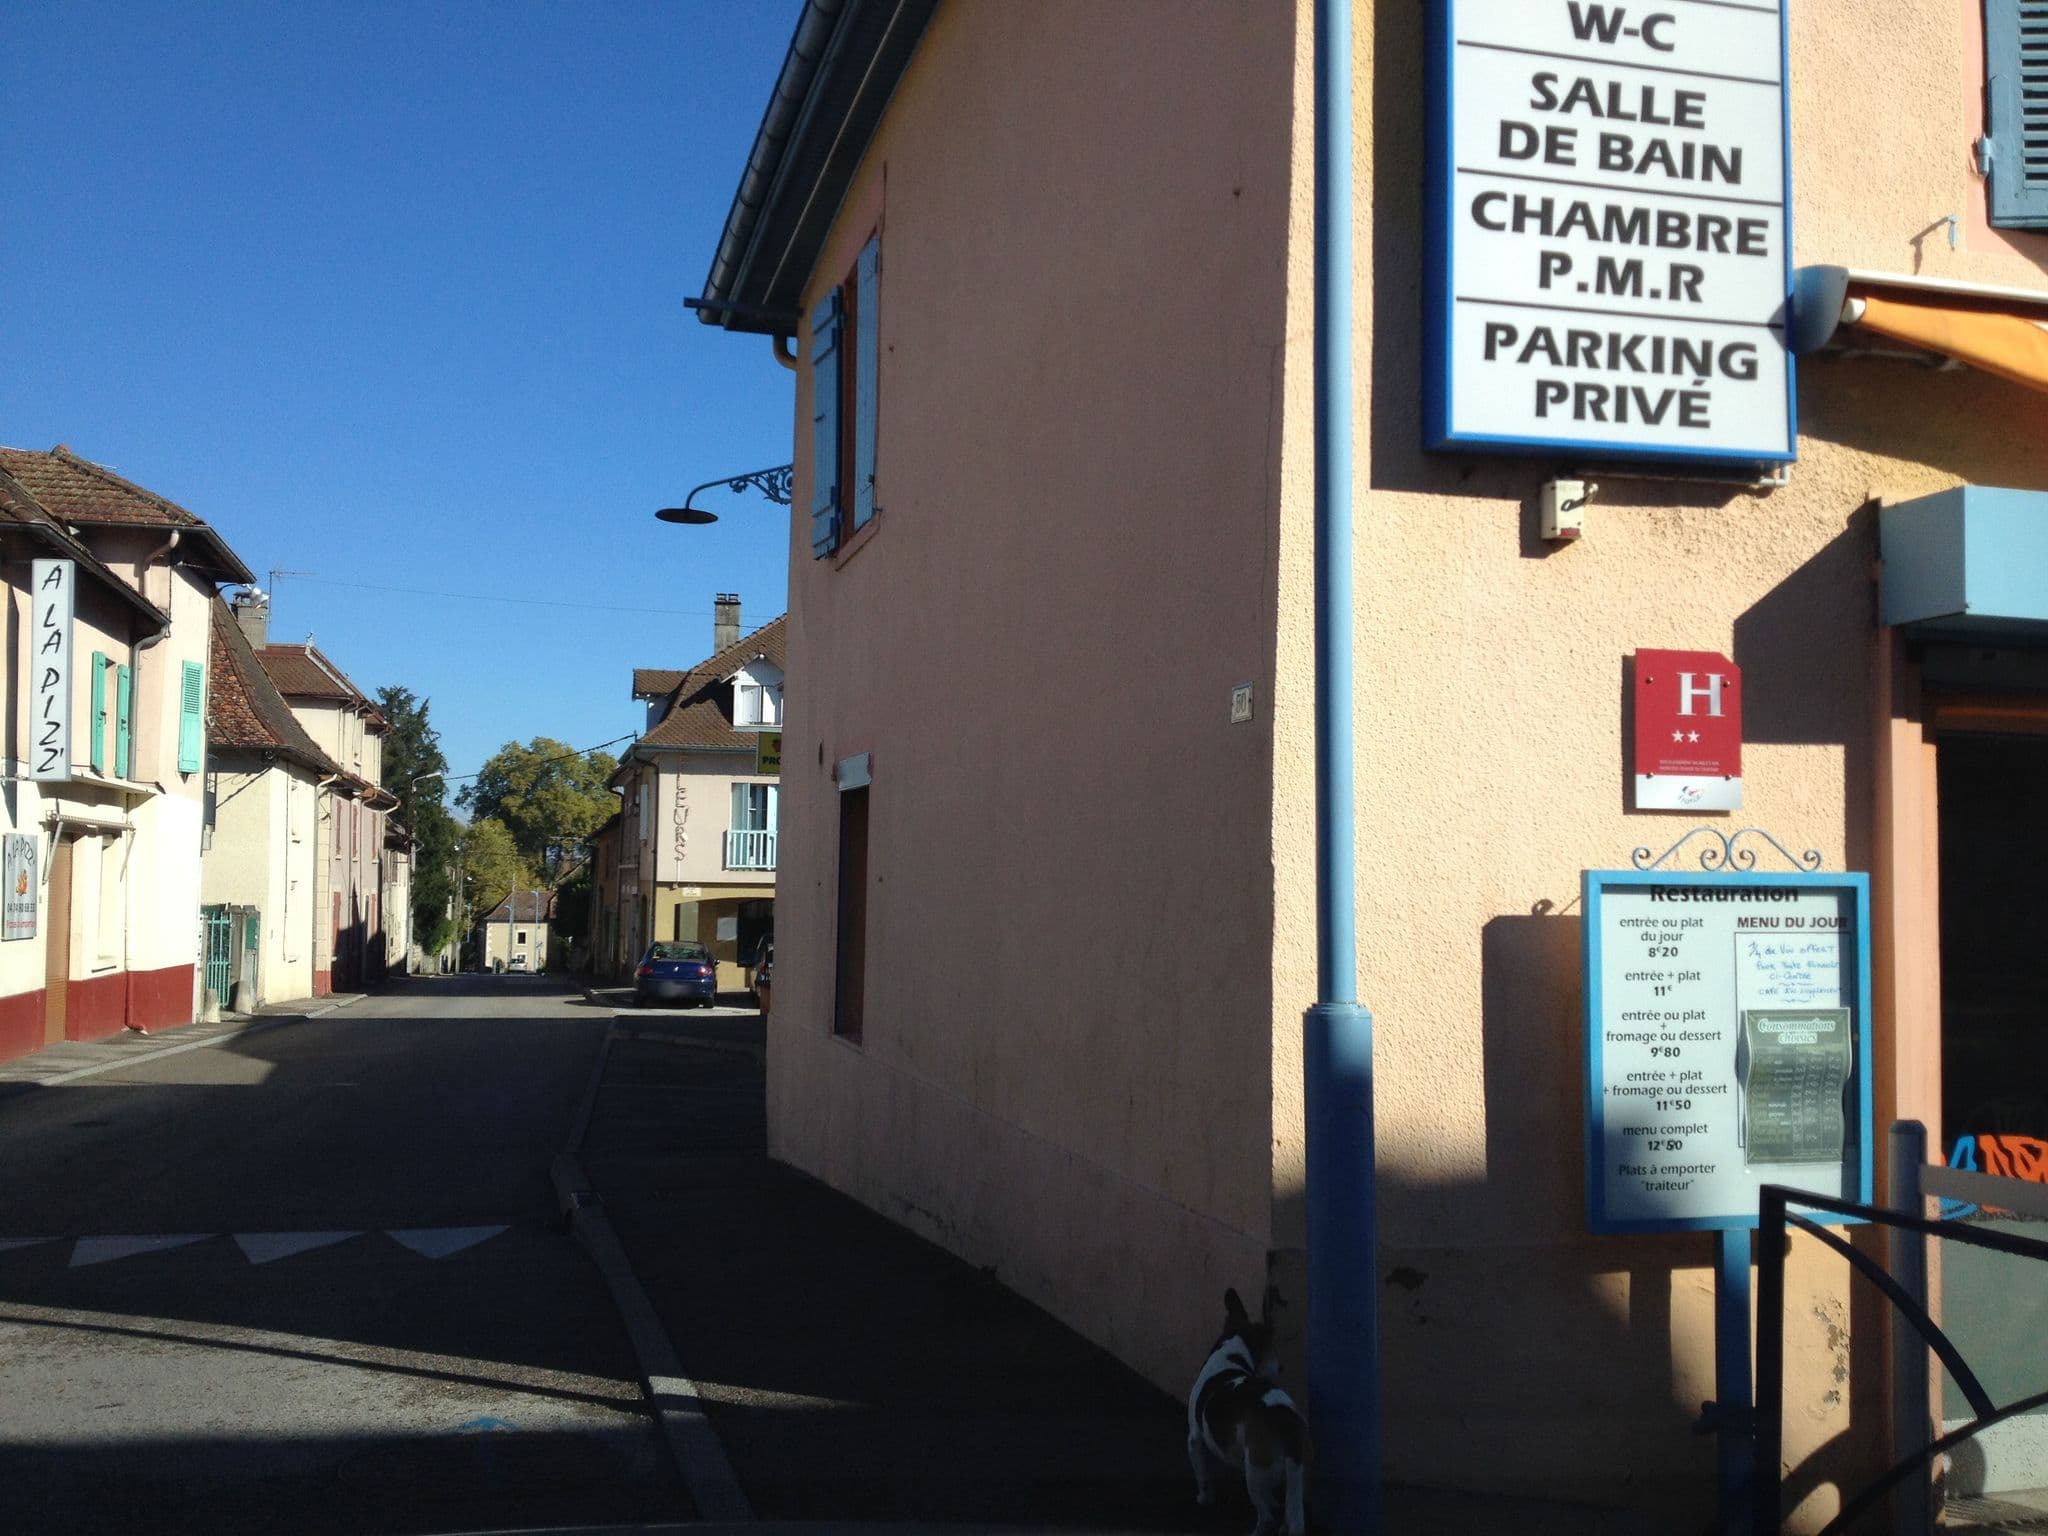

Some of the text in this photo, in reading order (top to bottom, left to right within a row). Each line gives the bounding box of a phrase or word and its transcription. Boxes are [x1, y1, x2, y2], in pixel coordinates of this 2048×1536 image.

[1567, 0, 1676, 52] W-C
[1530, 72, 1706, 130] SALLE
[1498, 119, 1742, 185] DE BAIN
[1470, 190, 1770, 257] CHAMBRE
[1538, 250, 1705, 303] P.M.R
[1483, 321, 1759, 380] PARKING
[1534, 377, 1711, 430] PRIVÉ
[1675, 672, 1726, 717] H
[1650, 885, 1799, 902] Restauration
[1620, 917, 1704, 930] entrée ou plat
[1737, 917, 1848, 928] MENU DU JOUR
[1640, 931, 1684, 945] du jour
[1625, 971, 1664, 981] entrée
[1678, 971, 1701, 984] plat
[1621, 1010, 1706, 1022] entrée ou plat
[1606, 1030, 1722, 1044] fromage ou dessert
[1626, 1071, 1666, 1081] entrée
[1680, 1070, 1703, 1083] plat
[1613, 1085, 1664, 1098] fromage
[1666, 1087, 1682, 1095] ou
[1685, 1084, 1727, 1094] dessert
[1623, 1124, 1708, 1136] menu complet
[1619, 1164, 1716, 1177] Plats à emporter
